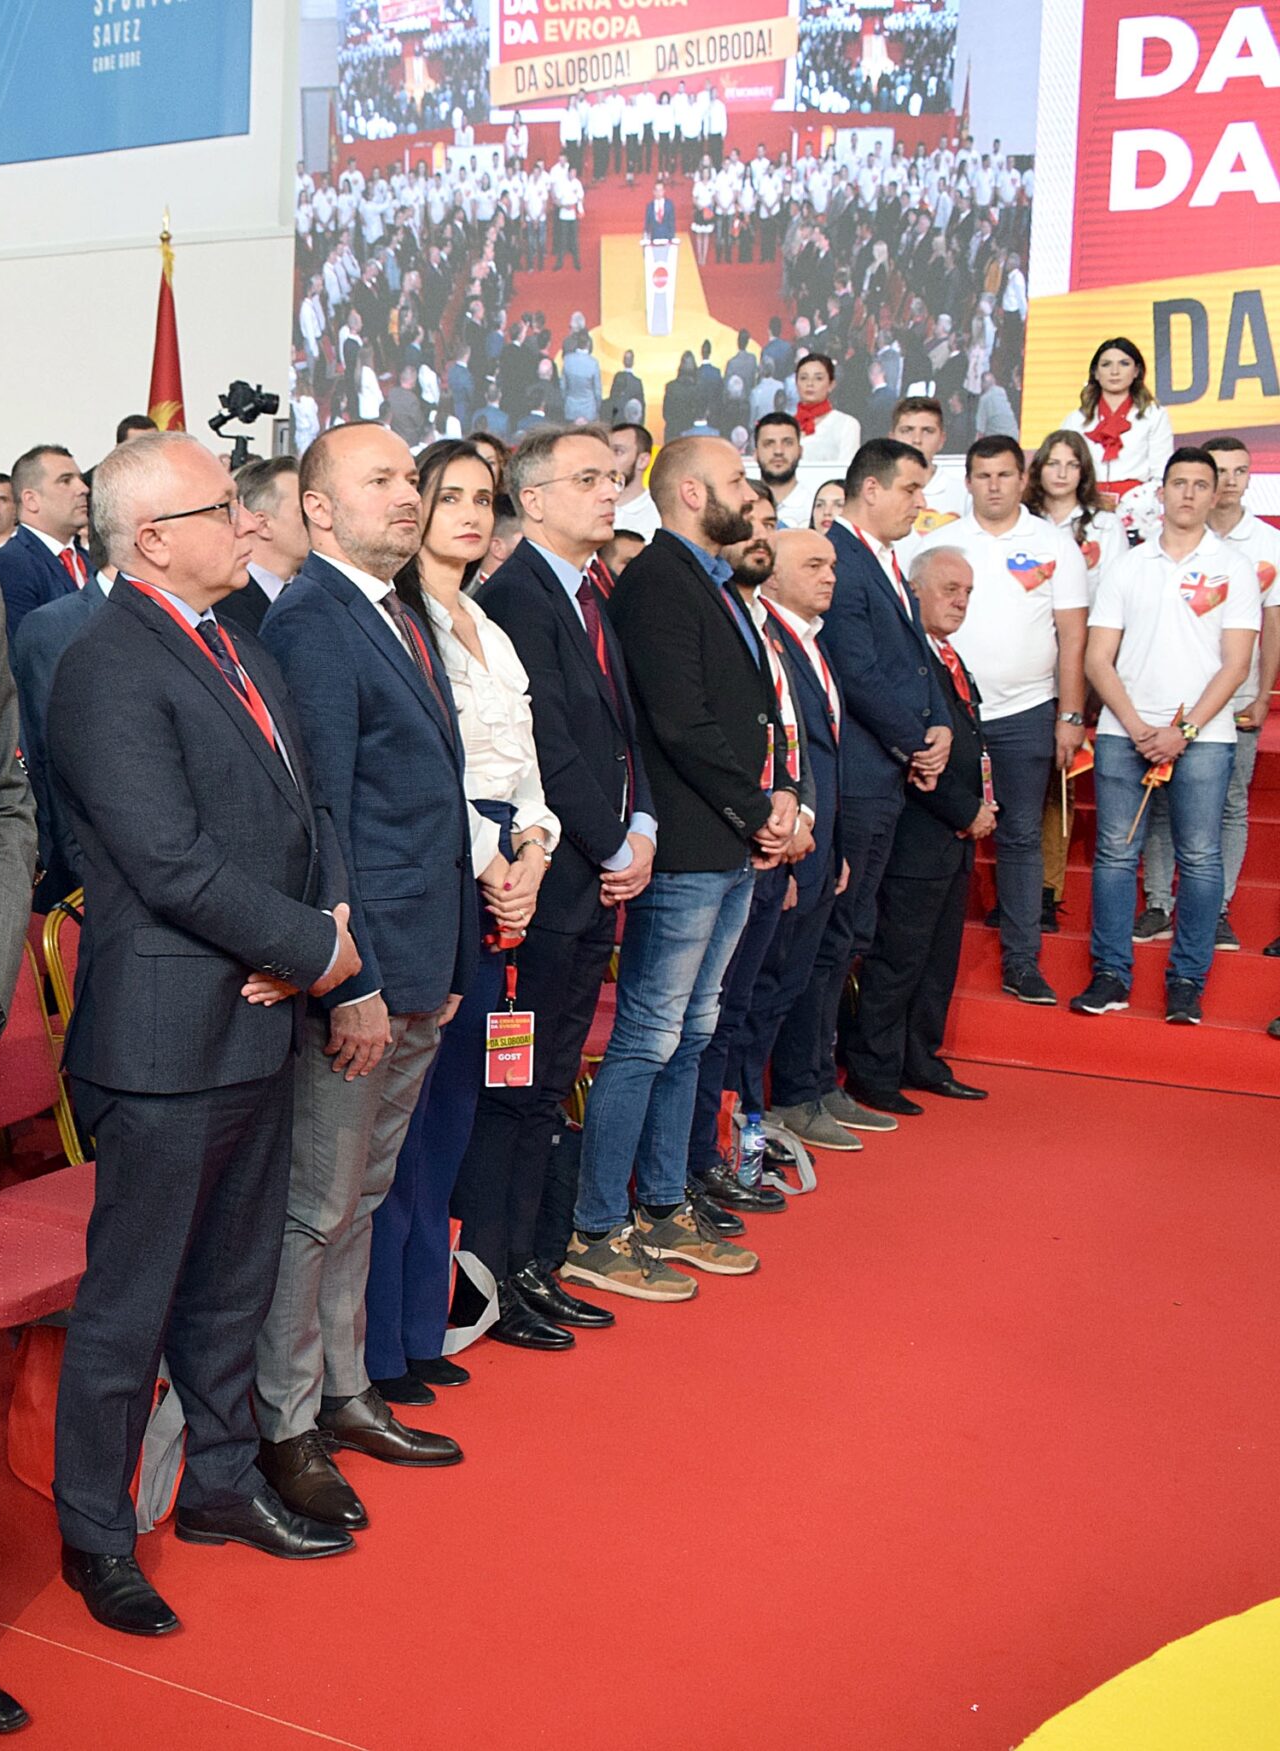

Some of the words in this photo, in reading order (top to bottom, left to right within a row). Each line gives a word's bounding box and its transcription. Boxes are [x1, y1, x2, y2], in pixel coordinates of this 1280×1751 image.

[93, 18, 141, 49] SAVEZ
[503, 18, 539, 45] DA
[544, 15, 642, 42] EVROPA
[515, 63, 539, 94] DA
[544, 48, 631, 89] SLOBODA!
[656, 42, 679, 73] DA
[685, 28, 773, 68] SLOBODA!
[1115, 6, 1280, 100] DA
[1109, 121, 1280, 212] DA
[1153, 290, 1280, 406] DA
[498, 1053, 522, 1061] GOST
